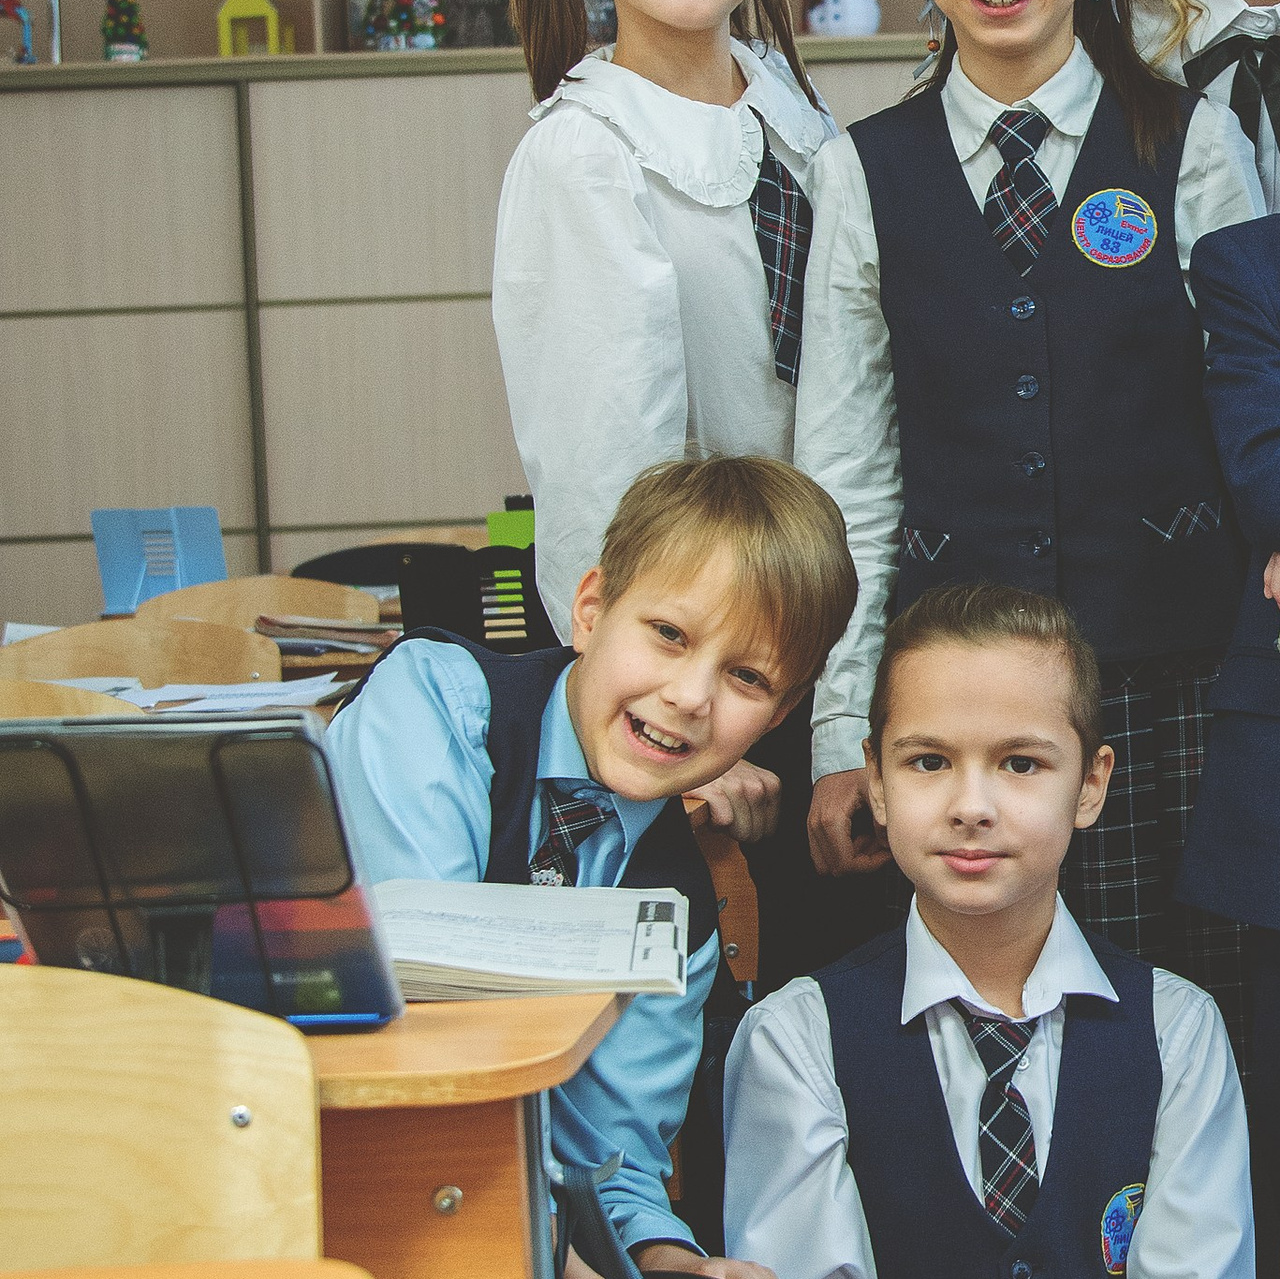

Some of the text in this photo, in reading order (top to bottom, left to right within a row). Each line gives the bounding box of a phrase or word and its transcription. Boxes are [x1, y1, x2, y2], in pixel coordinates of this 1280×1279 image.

[1075, 217, 1151, 263] ЦЕНТР ОБРАЗОВАНИЯ
[1096, 225, 1134, 243] ЛИЦЕЙ
[1100, 238, 1121, 253] 83
